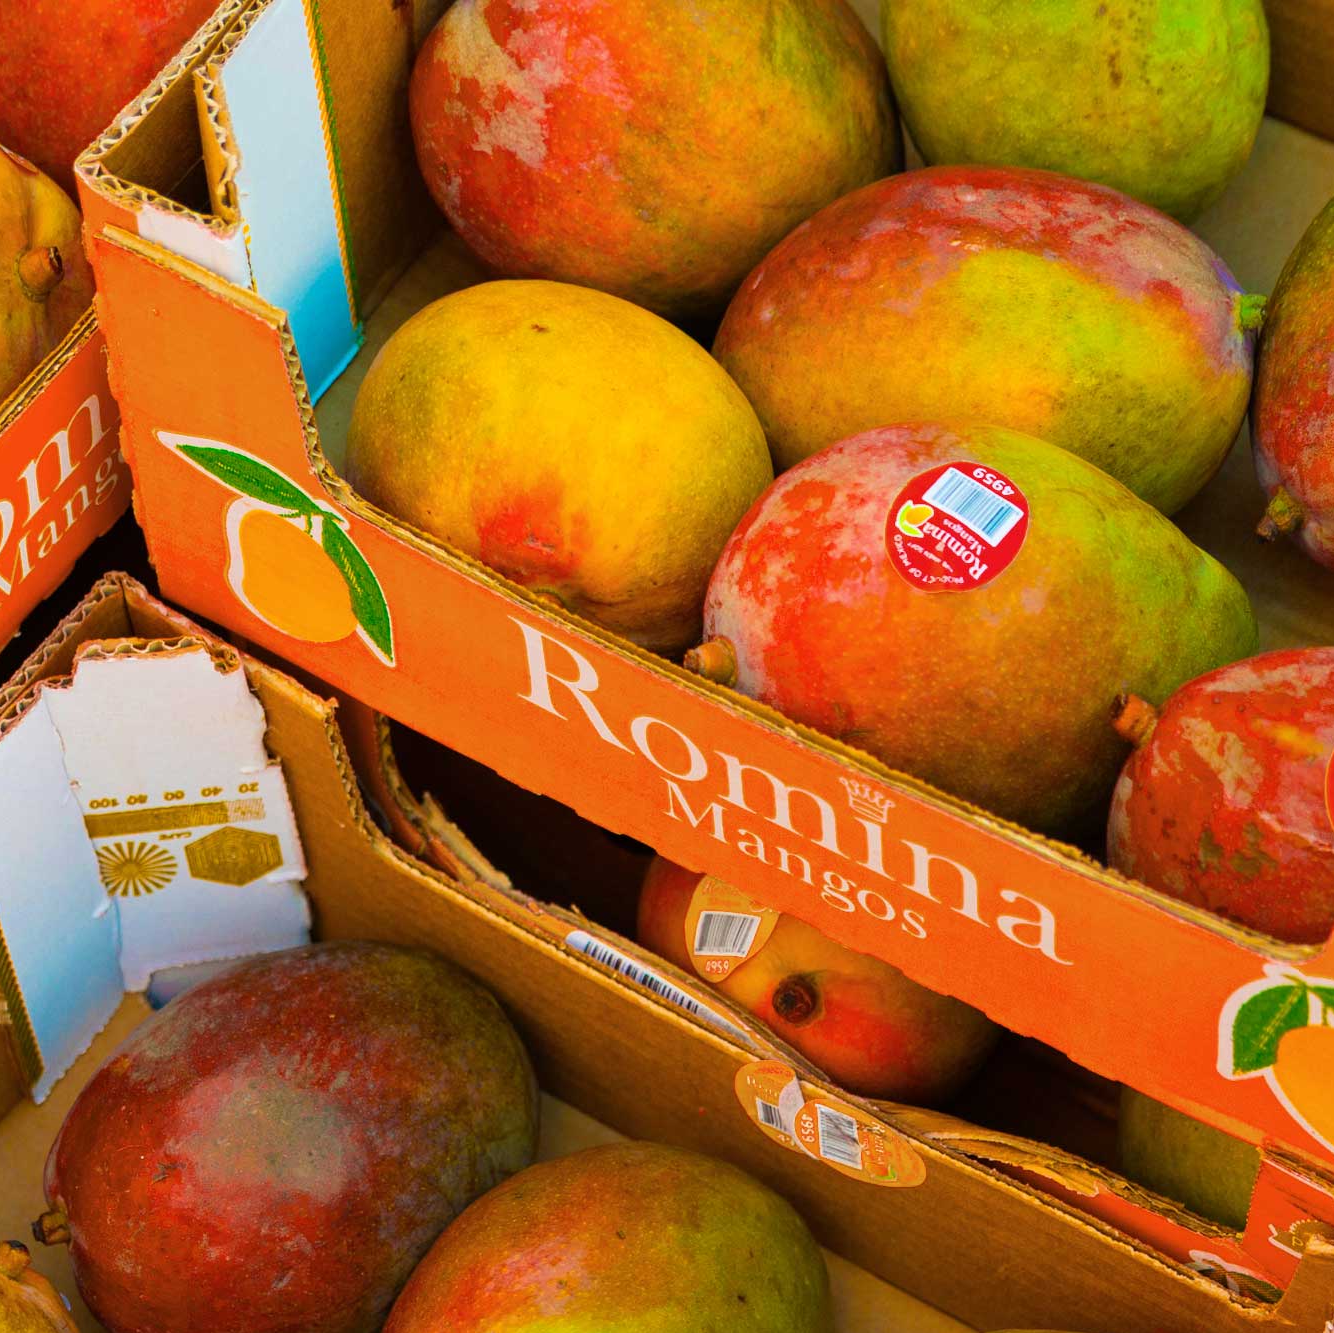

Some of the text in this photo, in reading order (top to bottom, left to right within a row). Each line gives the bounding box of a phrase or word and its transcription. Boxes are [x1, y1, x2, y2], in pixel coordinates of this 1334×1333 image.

[972, 467, 1015, 496] 4959
[922, 522, 988, 580] Romina
[942, 519, 986, 556] Mangos
[201, 786, 223, 797] 40
[238, 782, 259, 793] 20
[507, 614, 1074, 967] Romina
[89, 798, 120, 810] 100
[661, 776, 927, 939] Mangos
[801, 1114, 815, 1143] 4959
